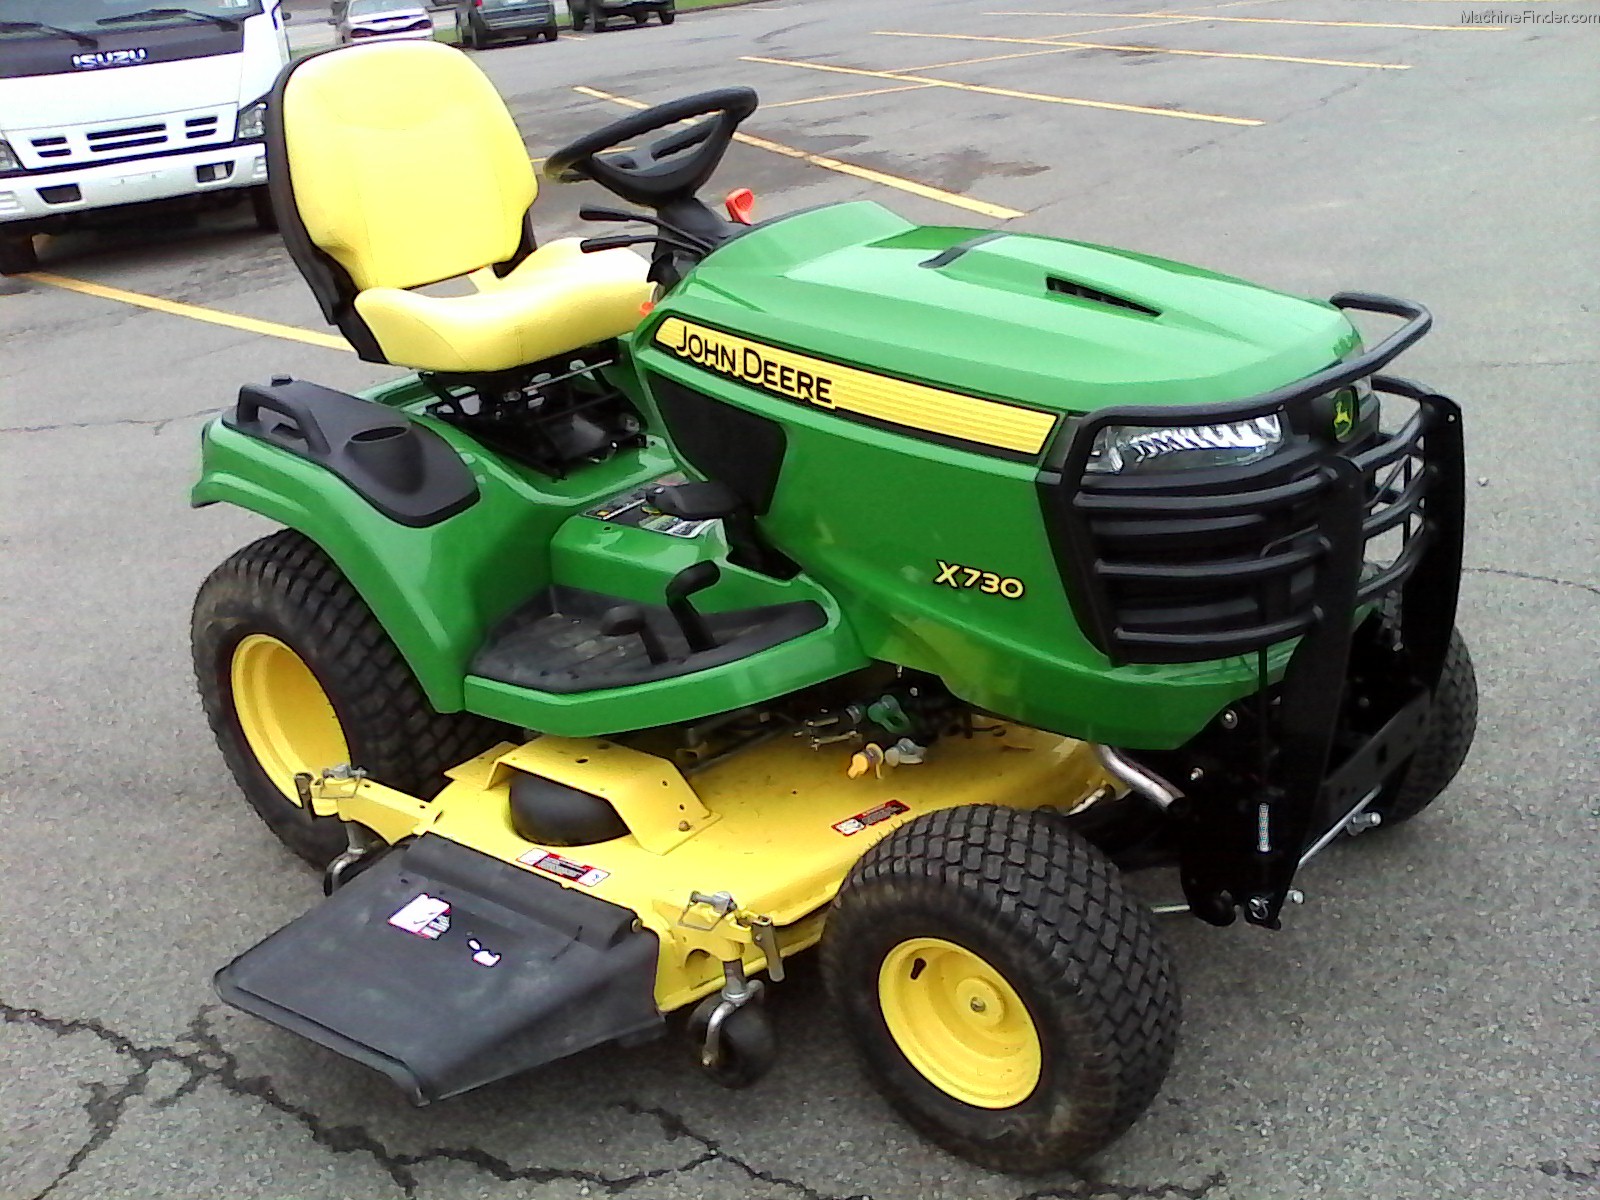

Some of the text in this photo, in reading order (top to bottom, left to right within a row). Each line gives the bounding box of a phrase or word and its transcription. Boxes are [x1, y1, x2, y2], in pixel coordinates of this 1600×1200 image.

[72, 48, 147, 68] ISUZU
[676, 325, 832, 404] JOHN DEERE
[934, 559, 1025, 599] X730
